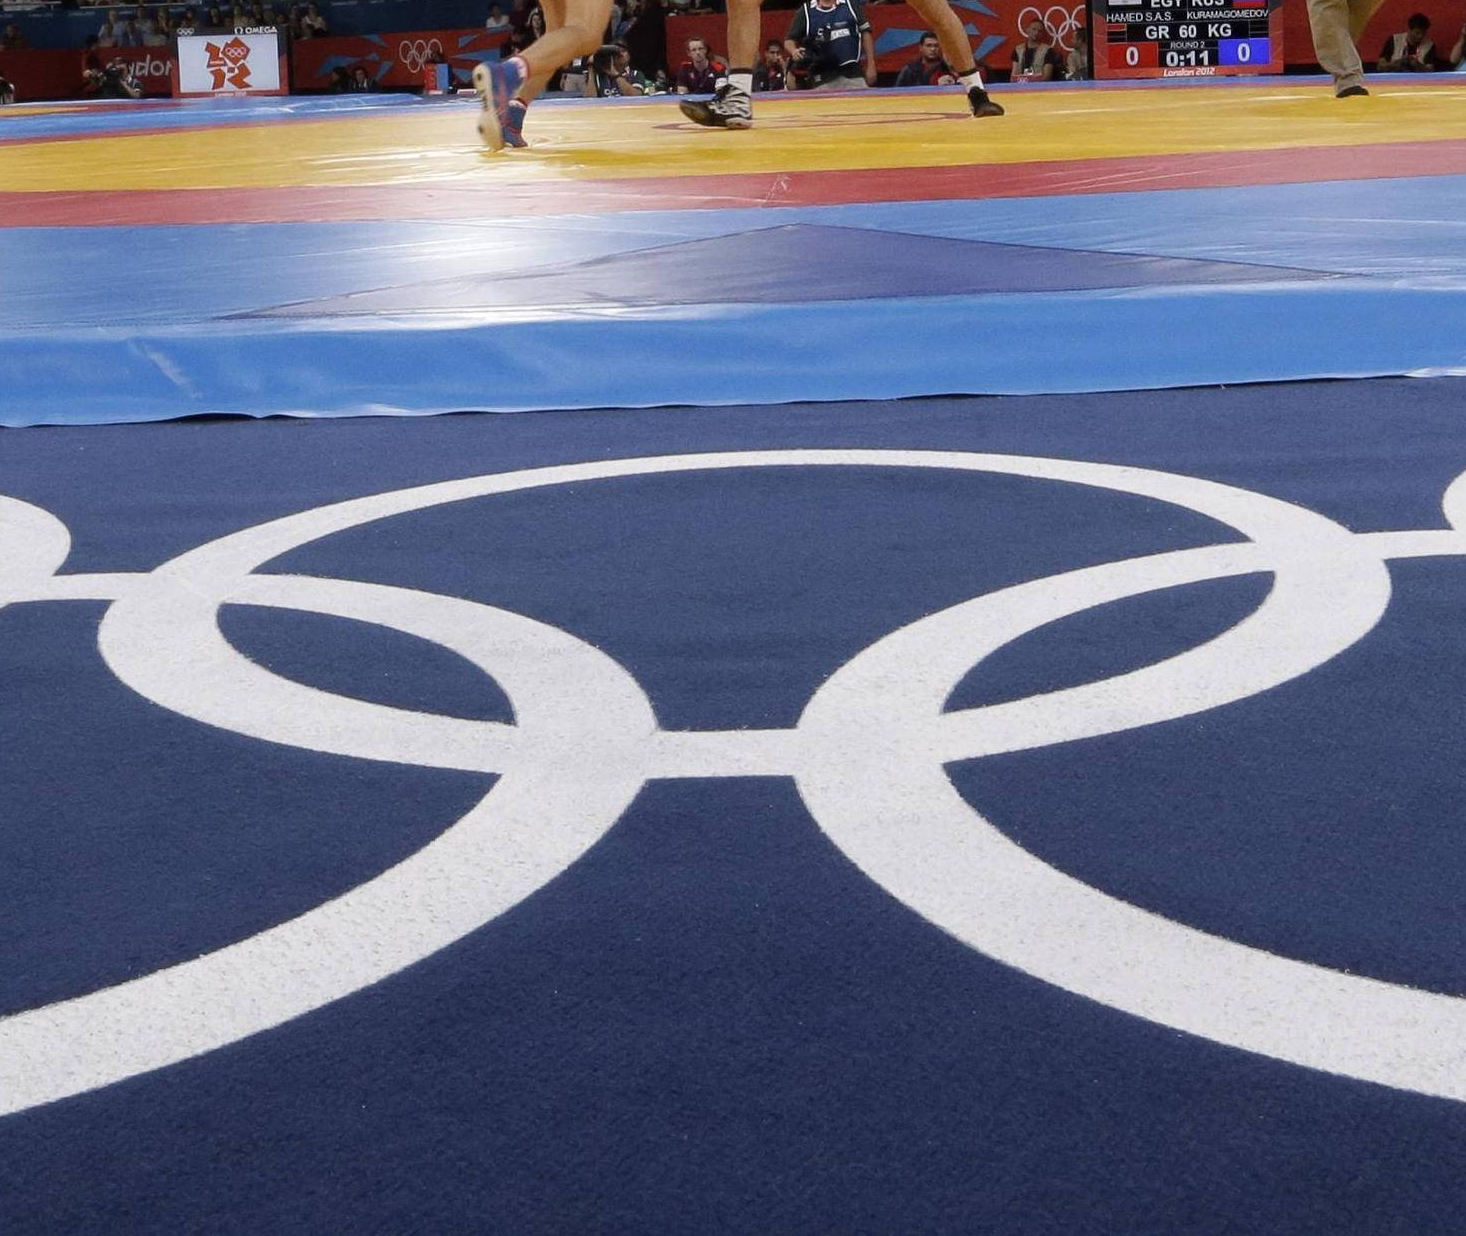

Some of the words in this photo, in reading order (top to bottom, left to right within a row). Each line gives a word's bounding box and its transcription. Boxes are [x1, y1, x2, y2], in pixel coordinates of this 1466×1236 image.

[1106, 12, 1143, 22] HAMED
[1145, 11, 1174, 21] S.A.S.
[1186, 8, 1270, 20] KURAMAGOMEDOV
[245, 26, 278, 35] OMEGA
[1145, 25, 1170, 40] GR
[1178, 24, 1197, 39] 60
[1207, 23, 1233, 37] KG
[1170, 41, 1199, 50] ROUND
[1200, 40, 1205, 48] 2
[1125, 45, 1139, 66] 0
[1237, 42, 1251, 62] 0
[1165, 50, 1210, 67] 0:11
[1163, 68, 1194, 78] London
[1195, 66, 1216, 76] 2012
